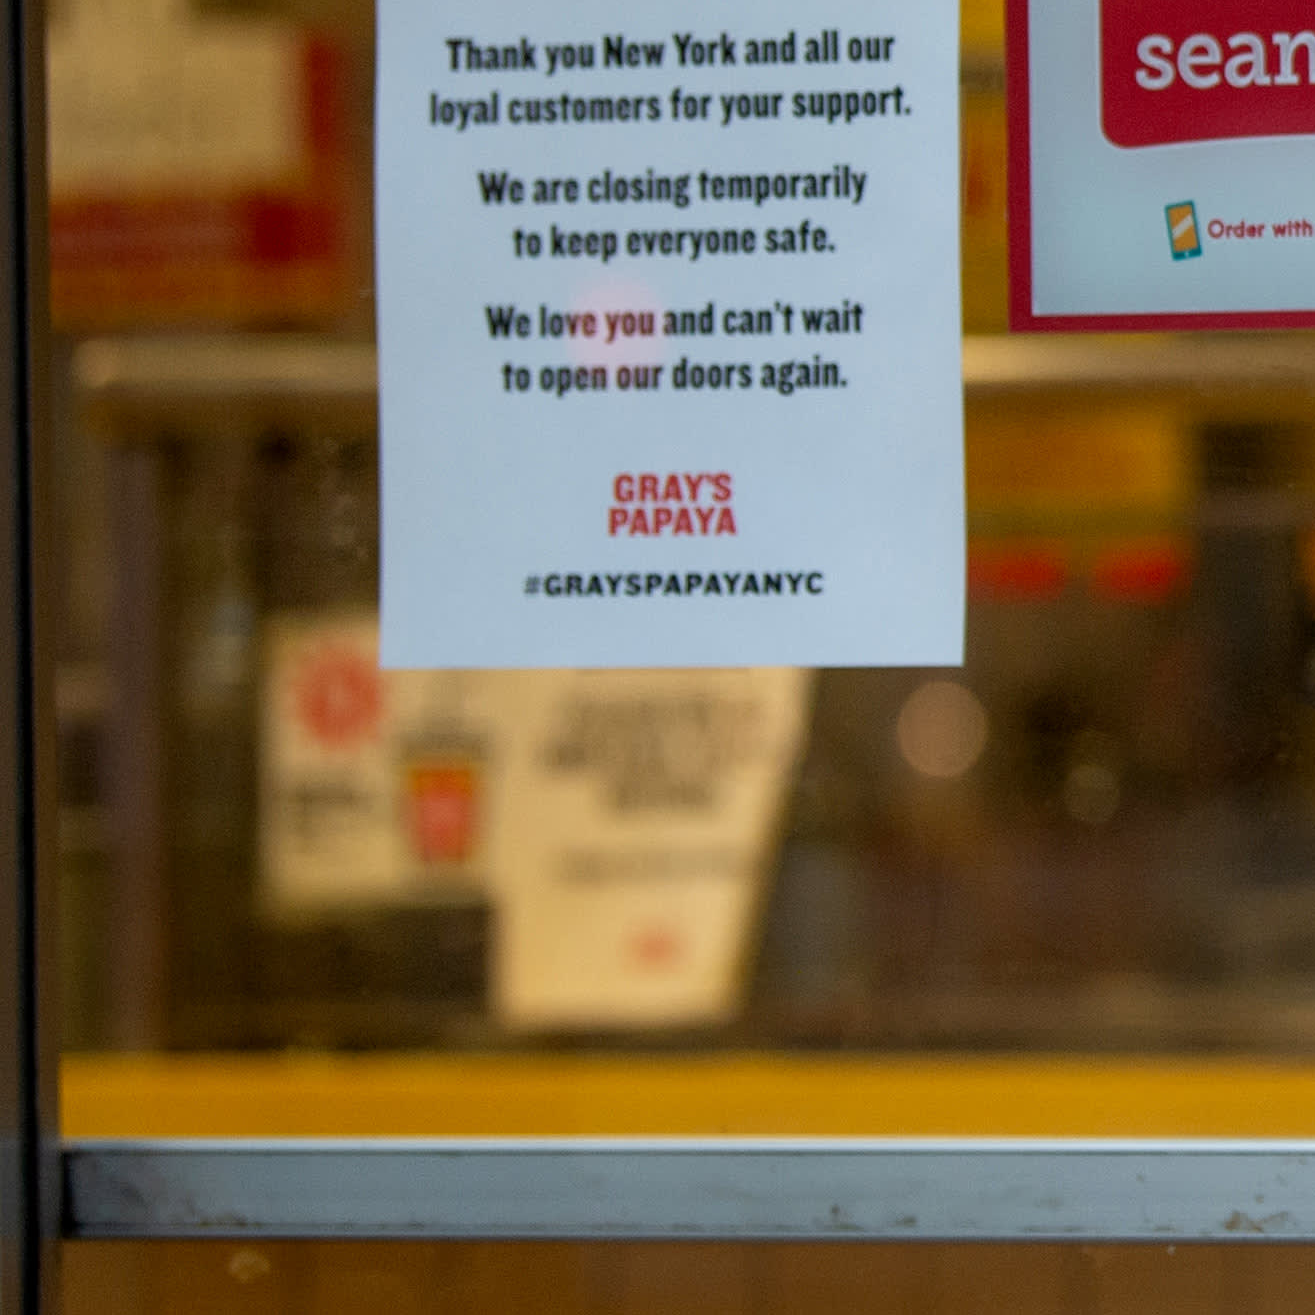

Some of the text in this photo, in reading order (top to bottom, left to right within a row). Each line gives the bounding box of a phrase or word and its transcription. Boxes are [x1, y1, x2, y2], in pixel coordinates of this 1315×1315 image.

[446, 30, 895, 75] Thank you New York and all our
[430, 86, 910, 131] loyal customers for your support.
[478, 165, 866, 208] We are closing temporarily
[513, 220, 835, 263] to keep everyone safe.
[1208, 219, 1265, 239] Order
[1272, 220, 1312, 237] with
[485, 301, 863, 343] We love you and can't wait
[502, 355, 847, 397] to open our doors again.
[614, 473, 731, 503] GRAY'S
[609, 507, 736, 536] PAPAYA
[525, 572, 822, 596] #GRAYSPAPAYANYC
